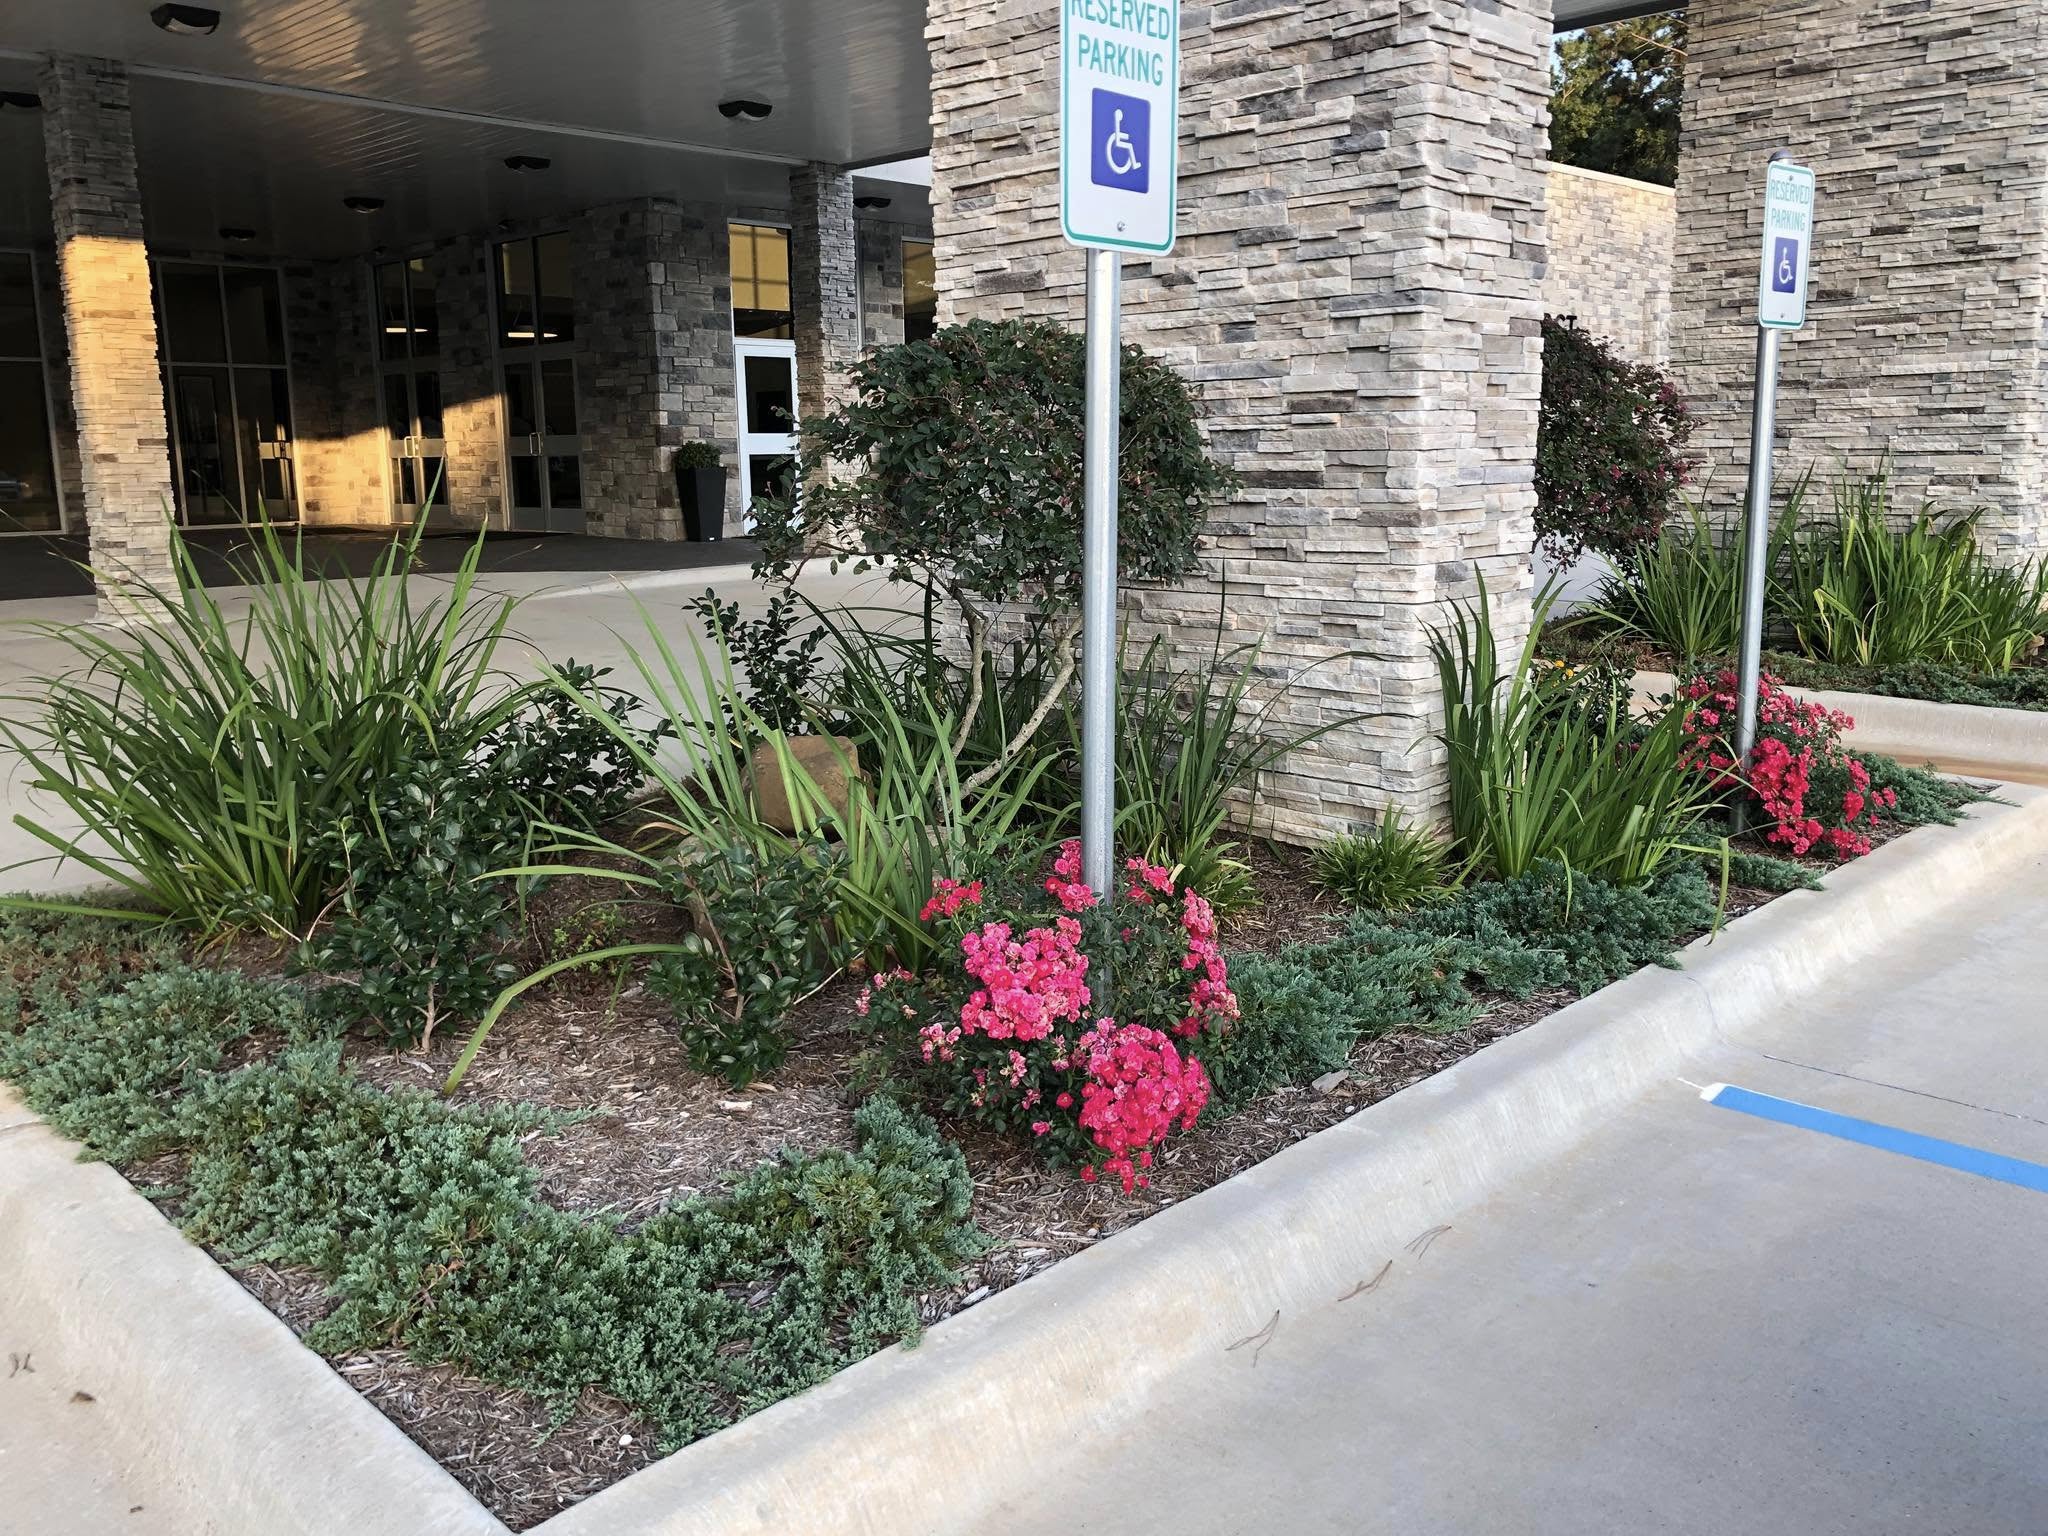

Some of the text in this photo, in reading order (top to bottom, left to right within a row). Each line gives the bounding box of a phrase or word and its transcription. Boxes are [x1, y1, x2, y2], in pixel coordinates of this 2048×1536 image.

[1078, 33, 1163, 86] PARKING
[1769, 179, 1810, 205] RESERVED
[1771, 207, 1806, 231] PARKING
